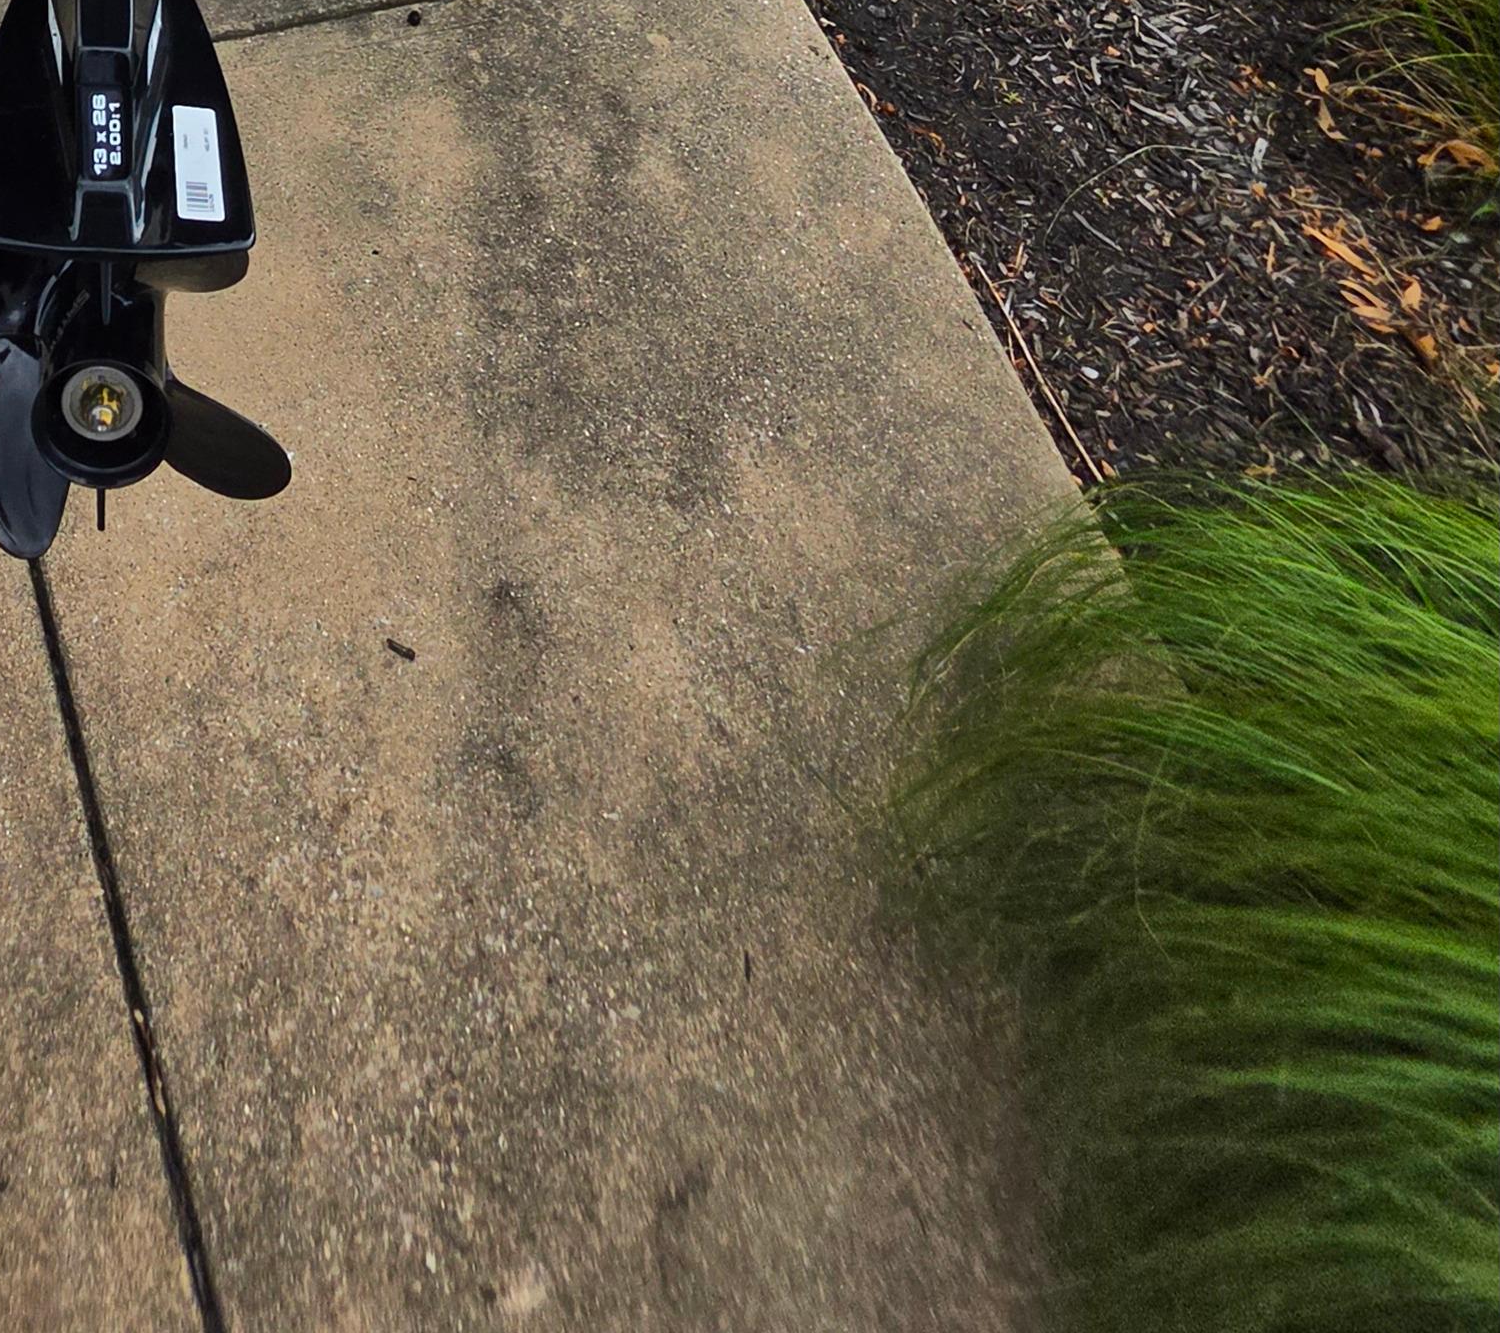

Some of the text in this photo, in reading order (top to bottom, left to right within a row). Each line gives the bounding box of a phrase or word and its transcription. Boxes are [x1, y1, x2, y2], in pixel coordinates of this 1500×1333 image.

[96, 130, 107, 143] x
[108, 102, 122, 166] 2.00:1
[93, 148, 108, 175] 13
